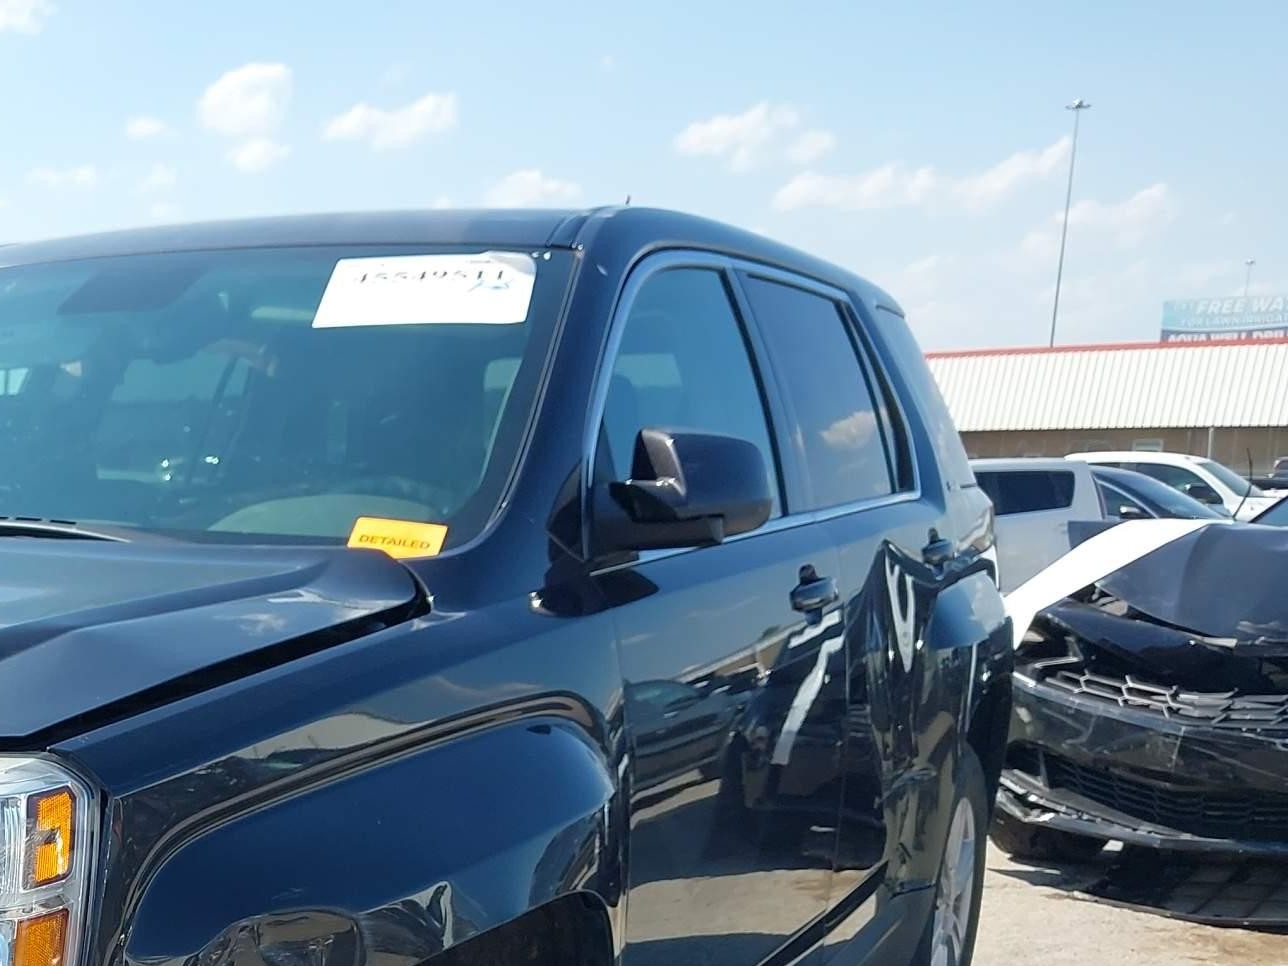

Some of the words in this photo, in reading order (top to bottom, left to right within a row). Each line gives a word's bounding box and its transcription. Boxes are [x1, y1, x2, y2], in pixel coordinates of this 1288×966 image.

[1195, 299, 1246, 314] FREE
[1251, 296, 1288, 312] WA
[359, 534, 431, 549] DETAILED
